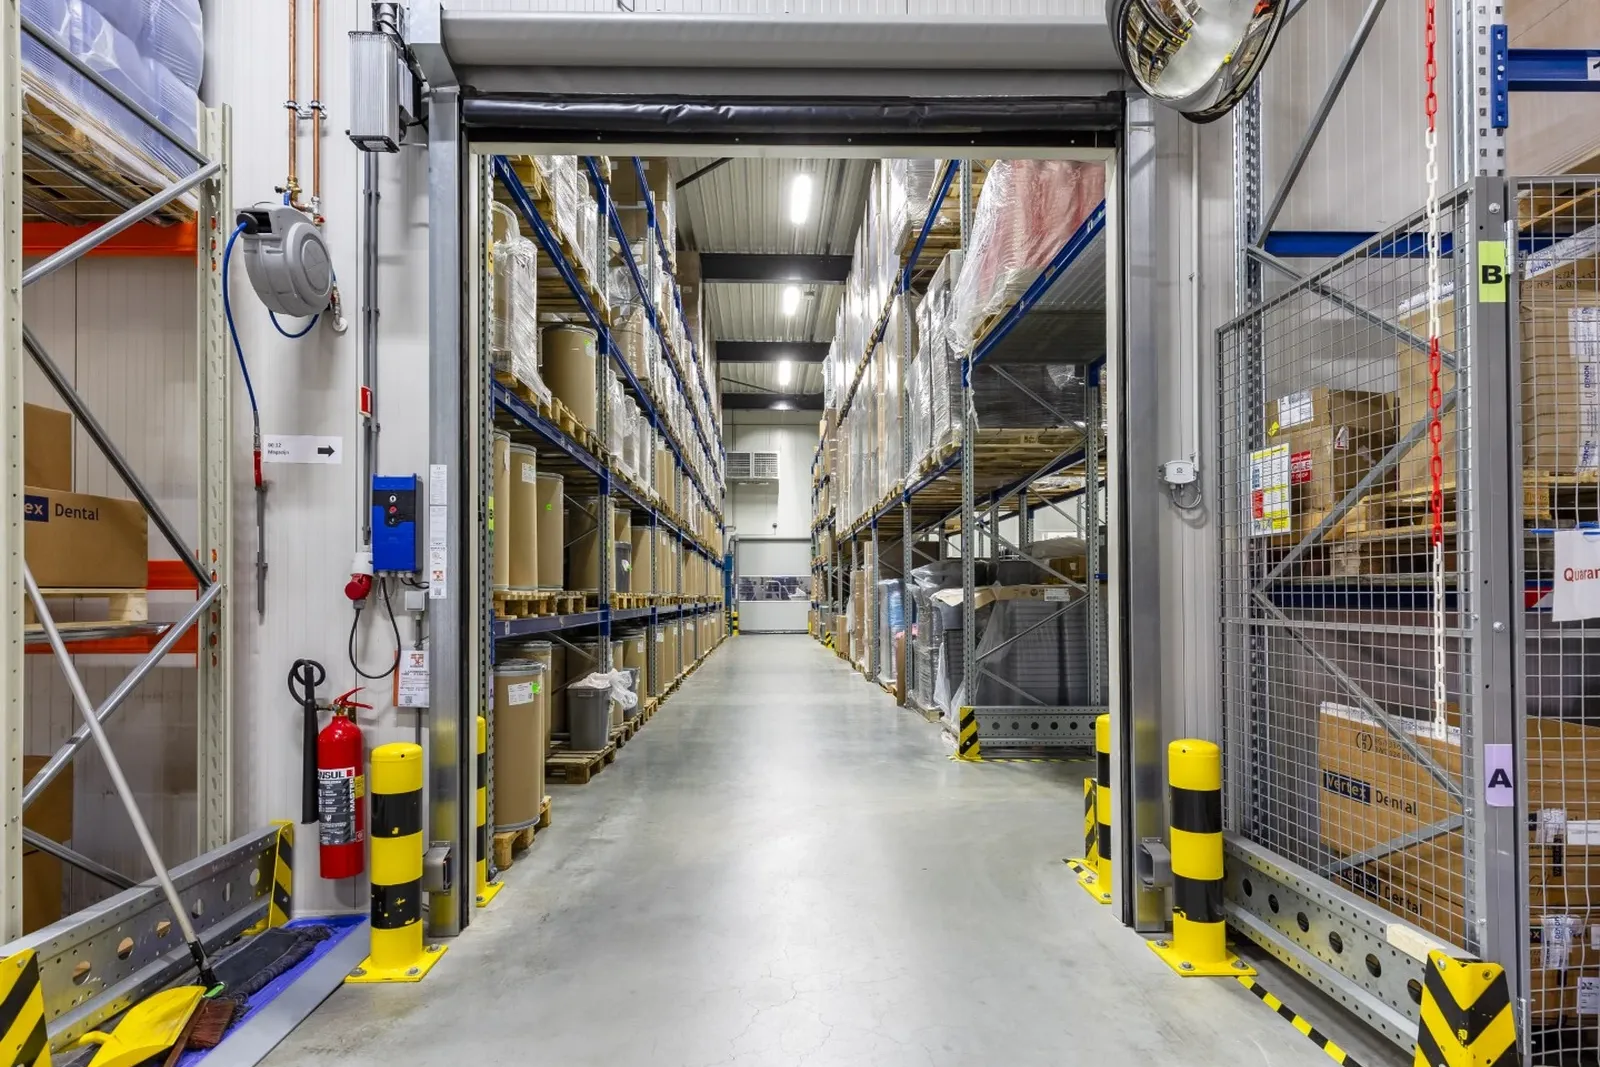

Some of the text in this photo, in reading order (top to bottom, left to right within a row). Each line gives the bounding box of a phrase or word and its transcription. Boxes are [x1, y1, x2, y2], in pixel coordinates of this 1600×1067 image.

[1481, 264, 1504, 285] B
[55, 502, 100, 522] Dental
[1487, 768, 1513, 789] A
[1375, 789, 1417, 816] Dental
